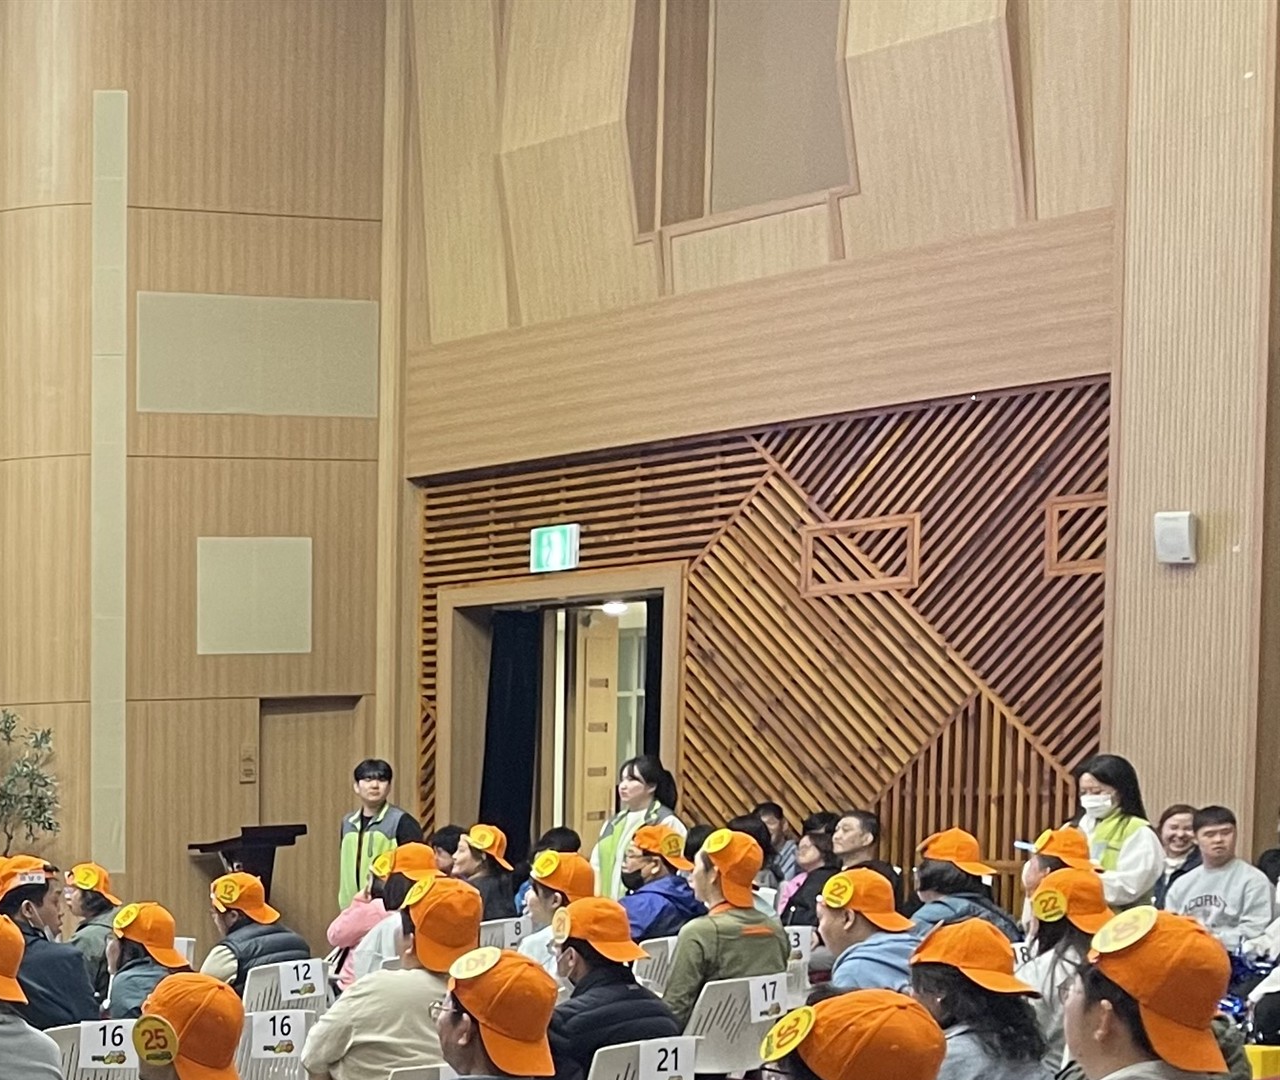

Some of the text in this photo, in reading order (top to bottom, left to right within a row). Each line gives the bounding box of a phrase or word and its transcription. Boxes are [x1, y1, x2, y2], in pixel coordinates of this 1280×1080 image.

[223, 884, 235, 896] 12
[828, 882, 848, 900] 22
[1040, 896, 1061, 913] 22
[514, 921, 522, 936] 8
[293, 963, 312, 982] 12
[761, 980, 777, 1002] 17
[98, 1024, 124, 1047] 16
[269, 1015, 292, 1037] 16
[141, 1028, 168, 1051] 25
[657, 1046, 679, 1072] 21
